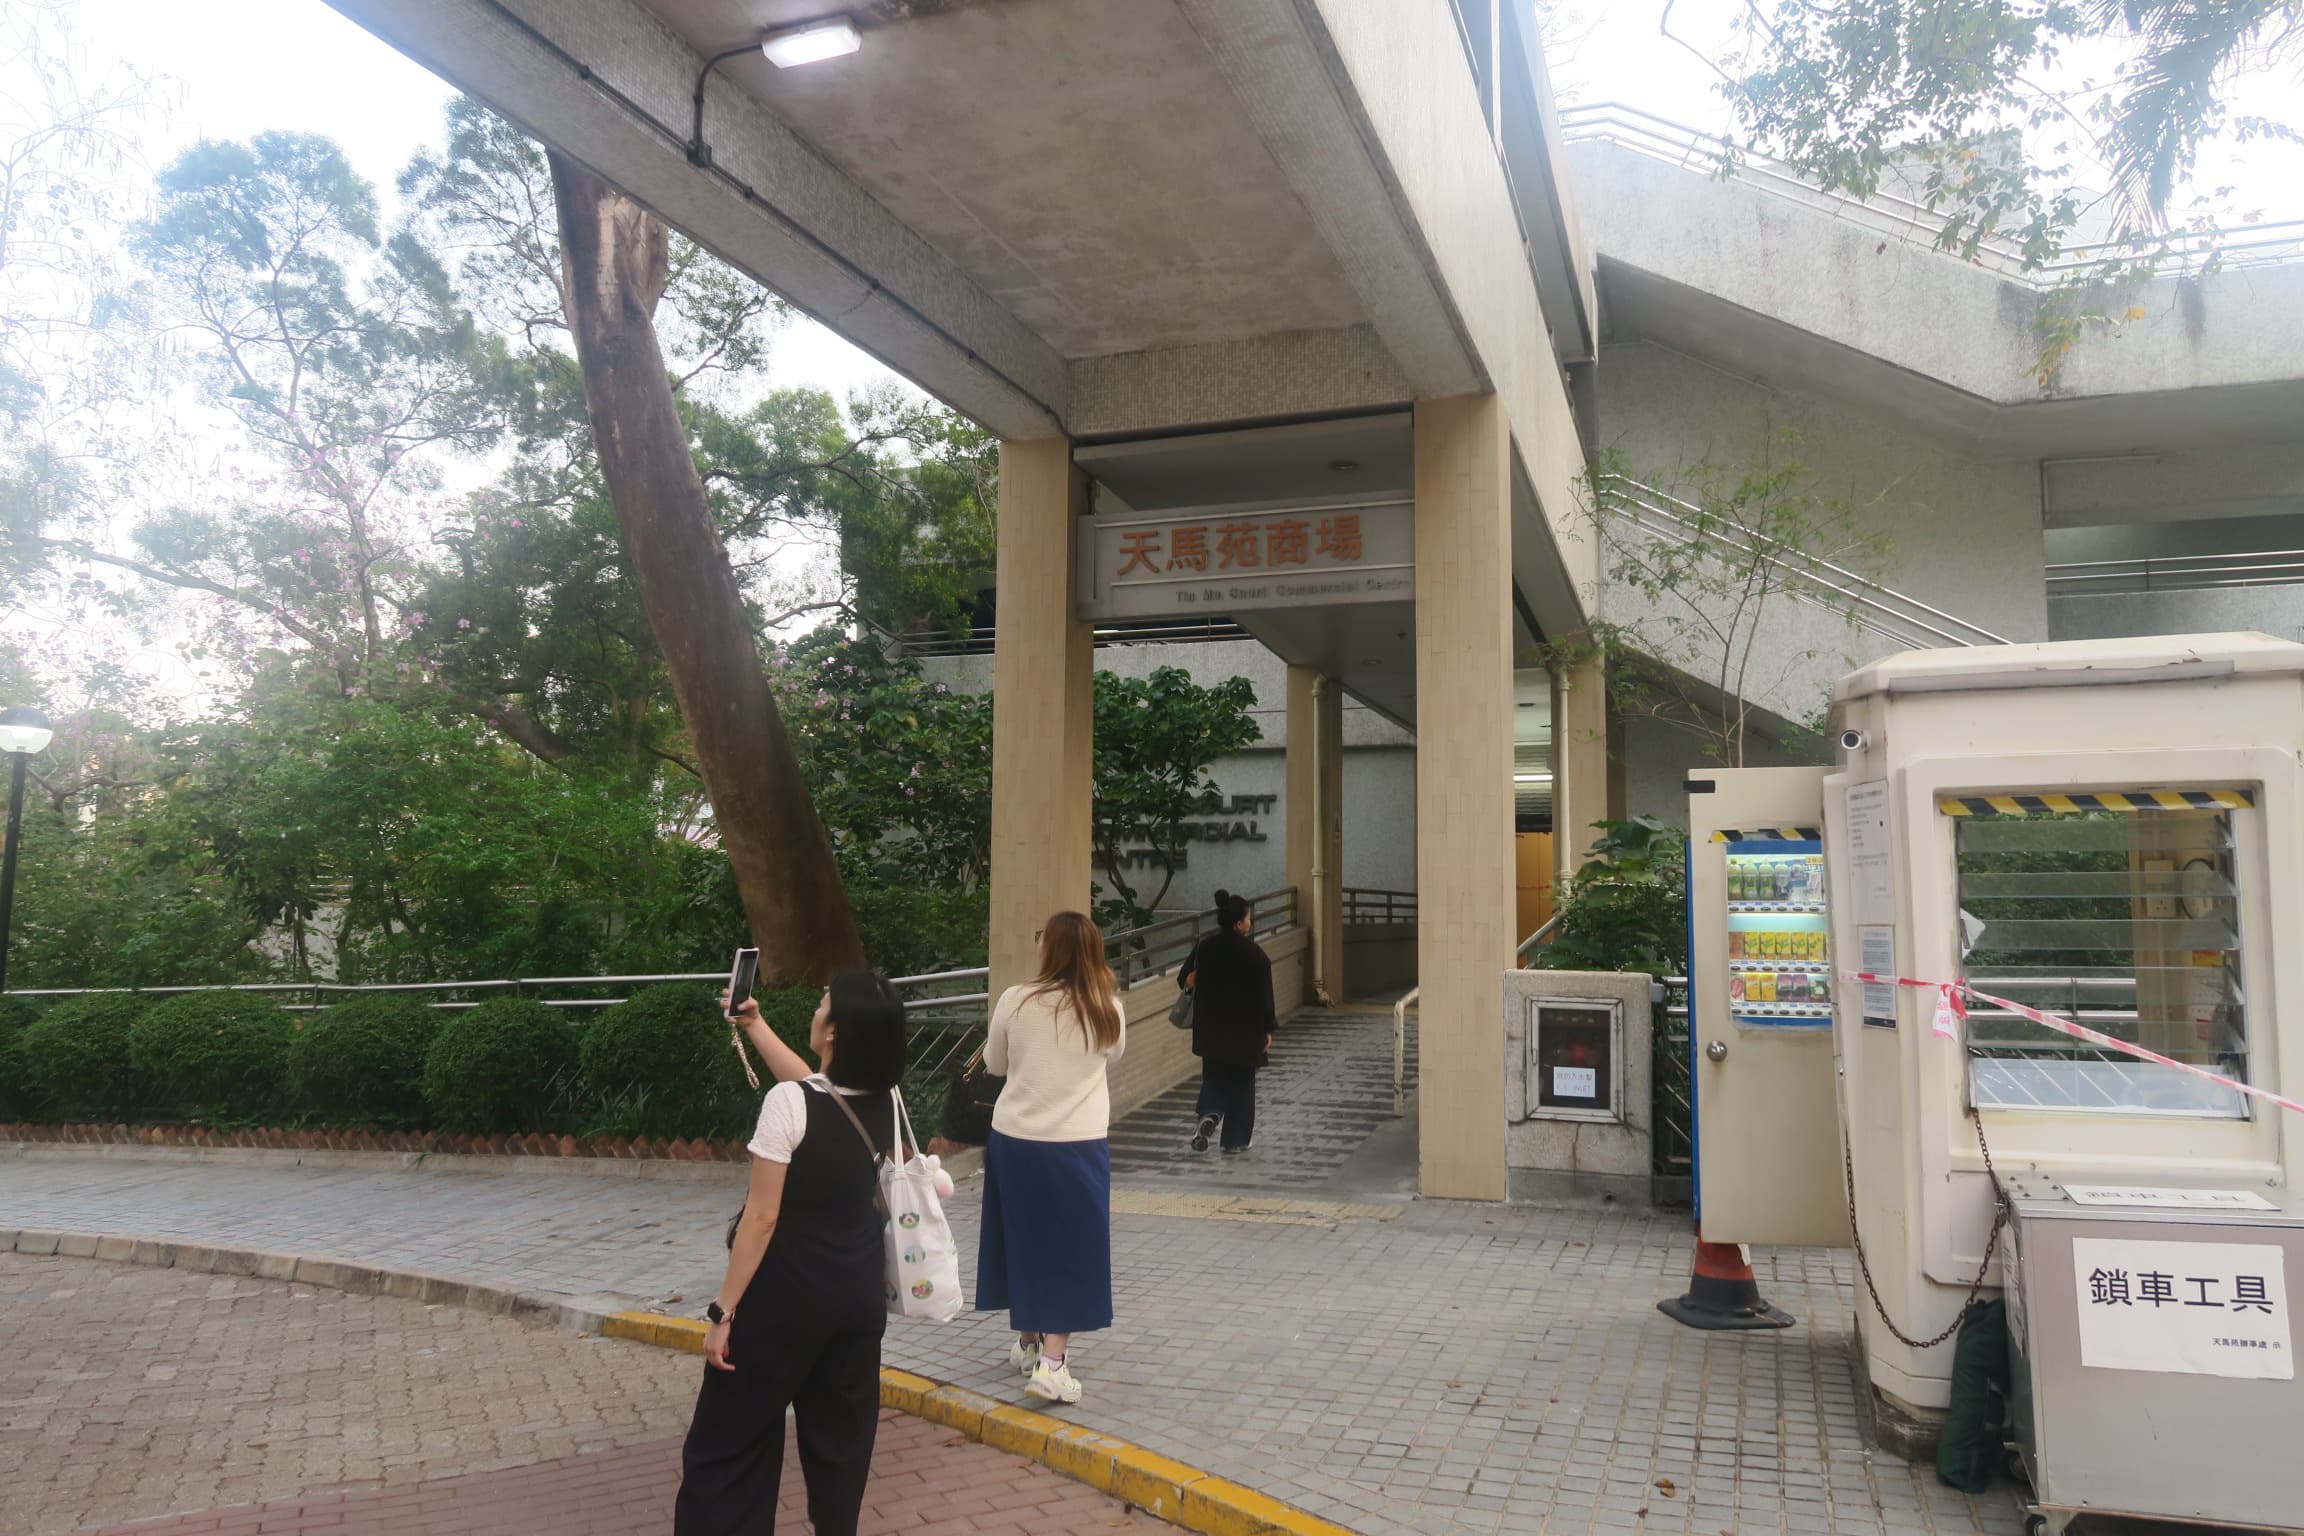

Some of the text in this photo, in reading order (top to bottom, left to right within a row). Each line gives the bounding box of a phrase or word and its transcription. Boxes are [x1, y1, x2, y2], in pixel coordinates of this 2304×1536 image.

[1117, 514, 1363, 576] 天馬苑商場
[1229, 585, 1267, 600] Court
[1276, 580, 1360, 597] Commercial
[2088, 1268, 2274, 1314] 鎖車工具
